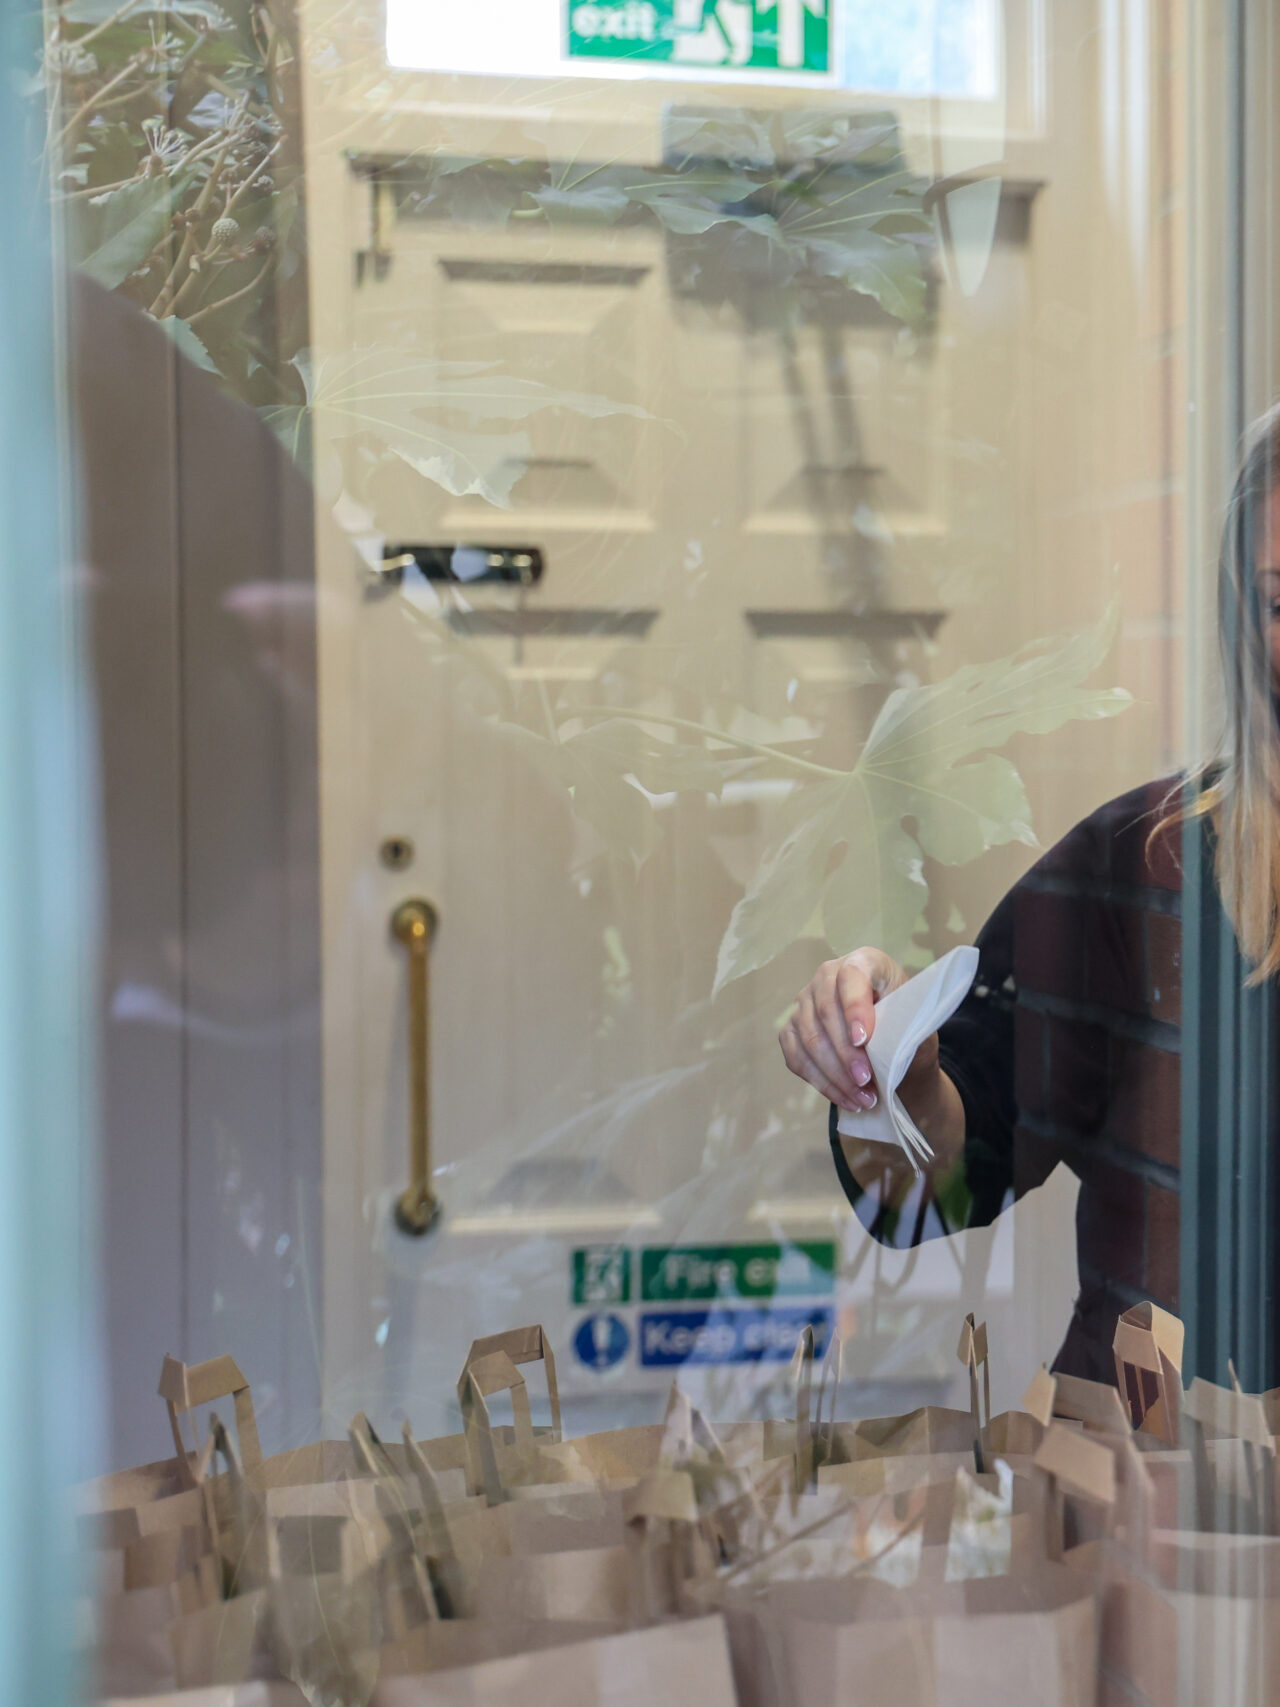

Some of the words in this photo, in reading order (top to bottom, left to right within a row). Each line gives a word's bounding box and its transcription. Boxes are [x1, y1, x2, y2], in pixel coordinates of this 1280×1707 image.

[572, 1, 656, 41] exit
[665, 1254, 737, 1290] Fire
[644, 1320, 737, 1353] Keep
[743, 1316, 827, 1350] cler
